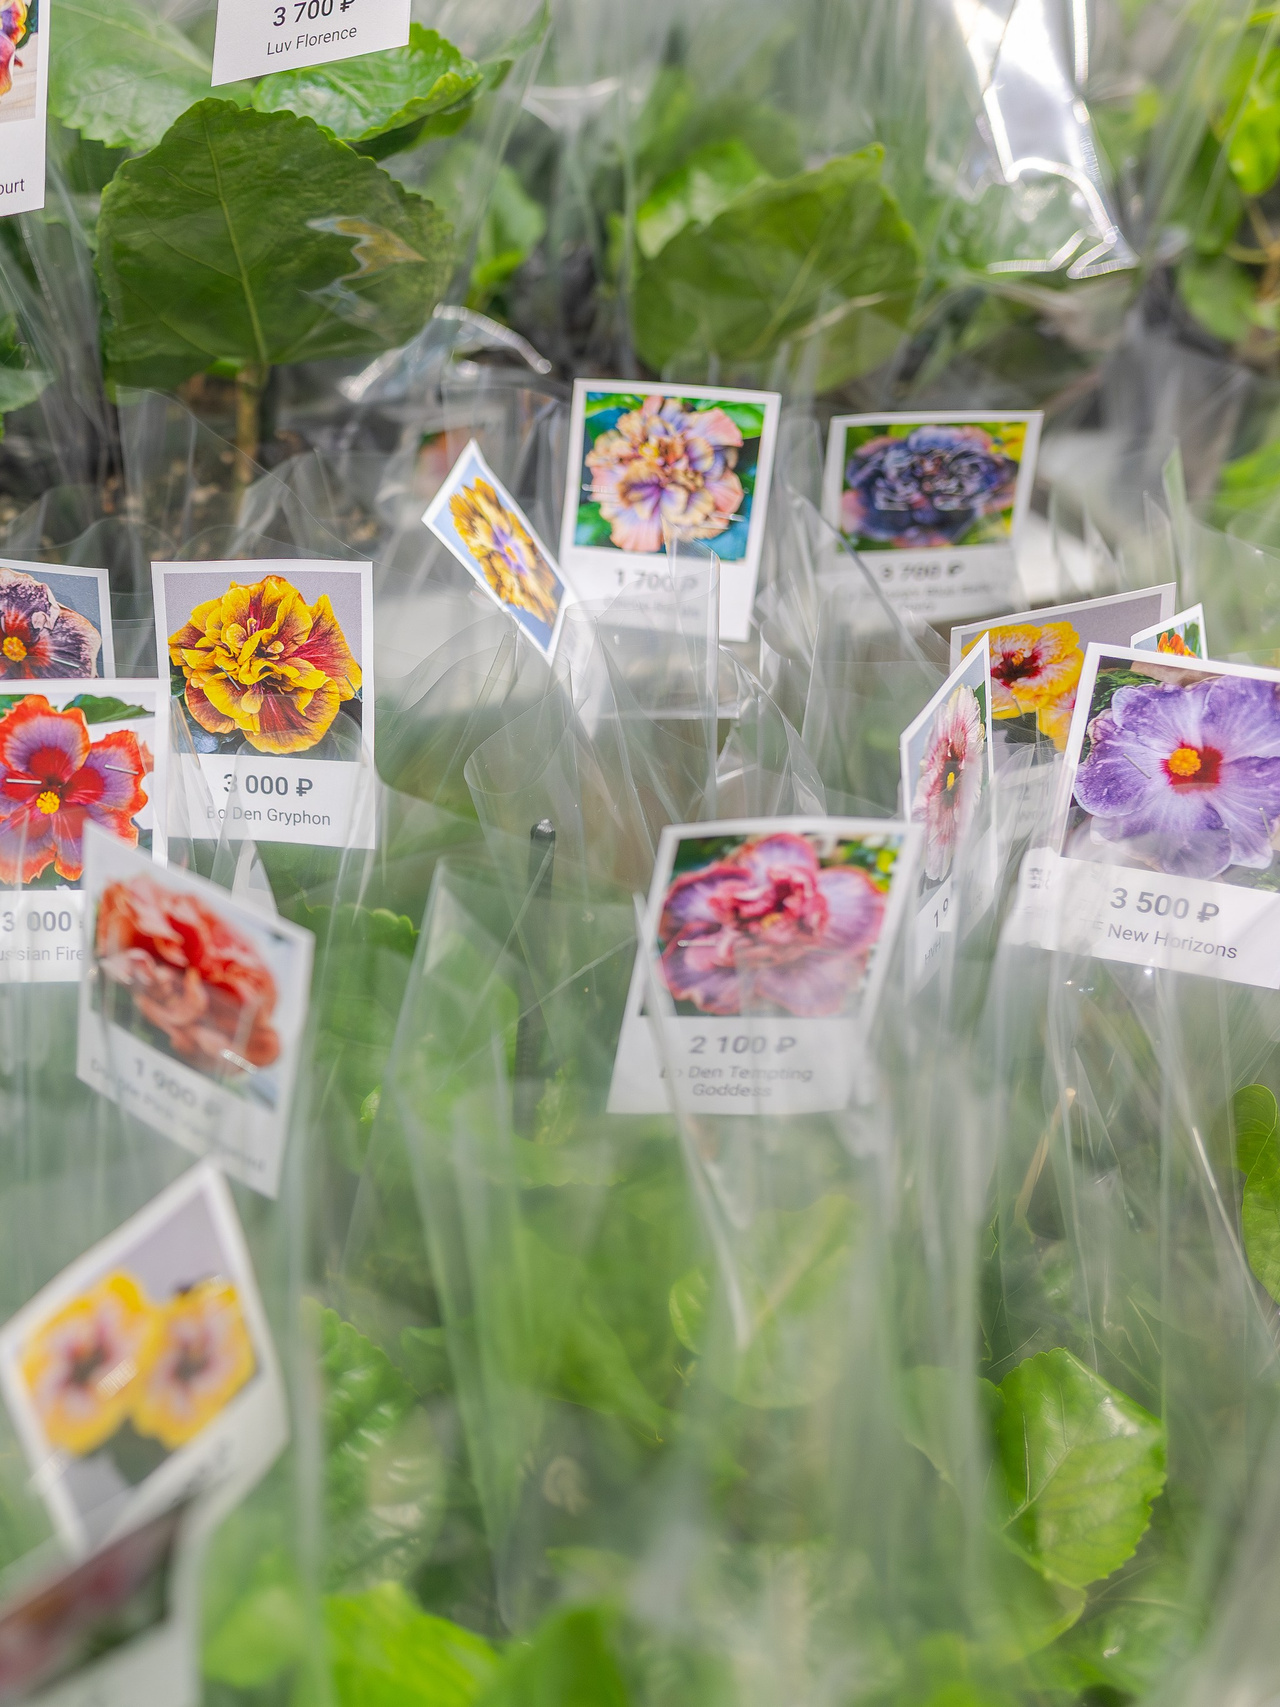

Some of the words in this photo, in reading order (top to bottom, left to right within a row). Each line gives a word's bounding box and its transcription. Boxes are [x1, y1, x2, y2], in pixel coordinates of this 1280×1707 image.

[273, 7, 286, 27] 3
[293, 0, 334, 23] 700
[266, 40, 292, 56] Luv
[296, 27, 357, 49] Florence
[614, 567, 625, 586] 1
[223, 773, 238, 793] 3
[245, 774, 289, 796] 000
[295, 777, 313, 797] ₽
[206, 806, 228, 819] Bo
[232, 806, 262, 821] Den
[267, 807, 331, 827] Gryphon
[1110, 887, 1128, 909] 3
[1136, 892, 1190, 920] 500
[1196, 902, 1220, 923] ₽
[2, 911, 15, 932] 3
[26, 911, 71, 932] 000
[934, 909, 939, 928] 1
[1107, 923, 1149, 943] New
[1154, 931, 1238, 959] Horizons
[688, 1035, 708, 1054] 2
[717, 1035, 767, 1054] 100
[133, 1057, 145, 1078] 1
[689, 1066, 723, 1080] Den
[729, 1065, 814, 1083] Tempting
[692, 1083, 772, 1098] Goddess
